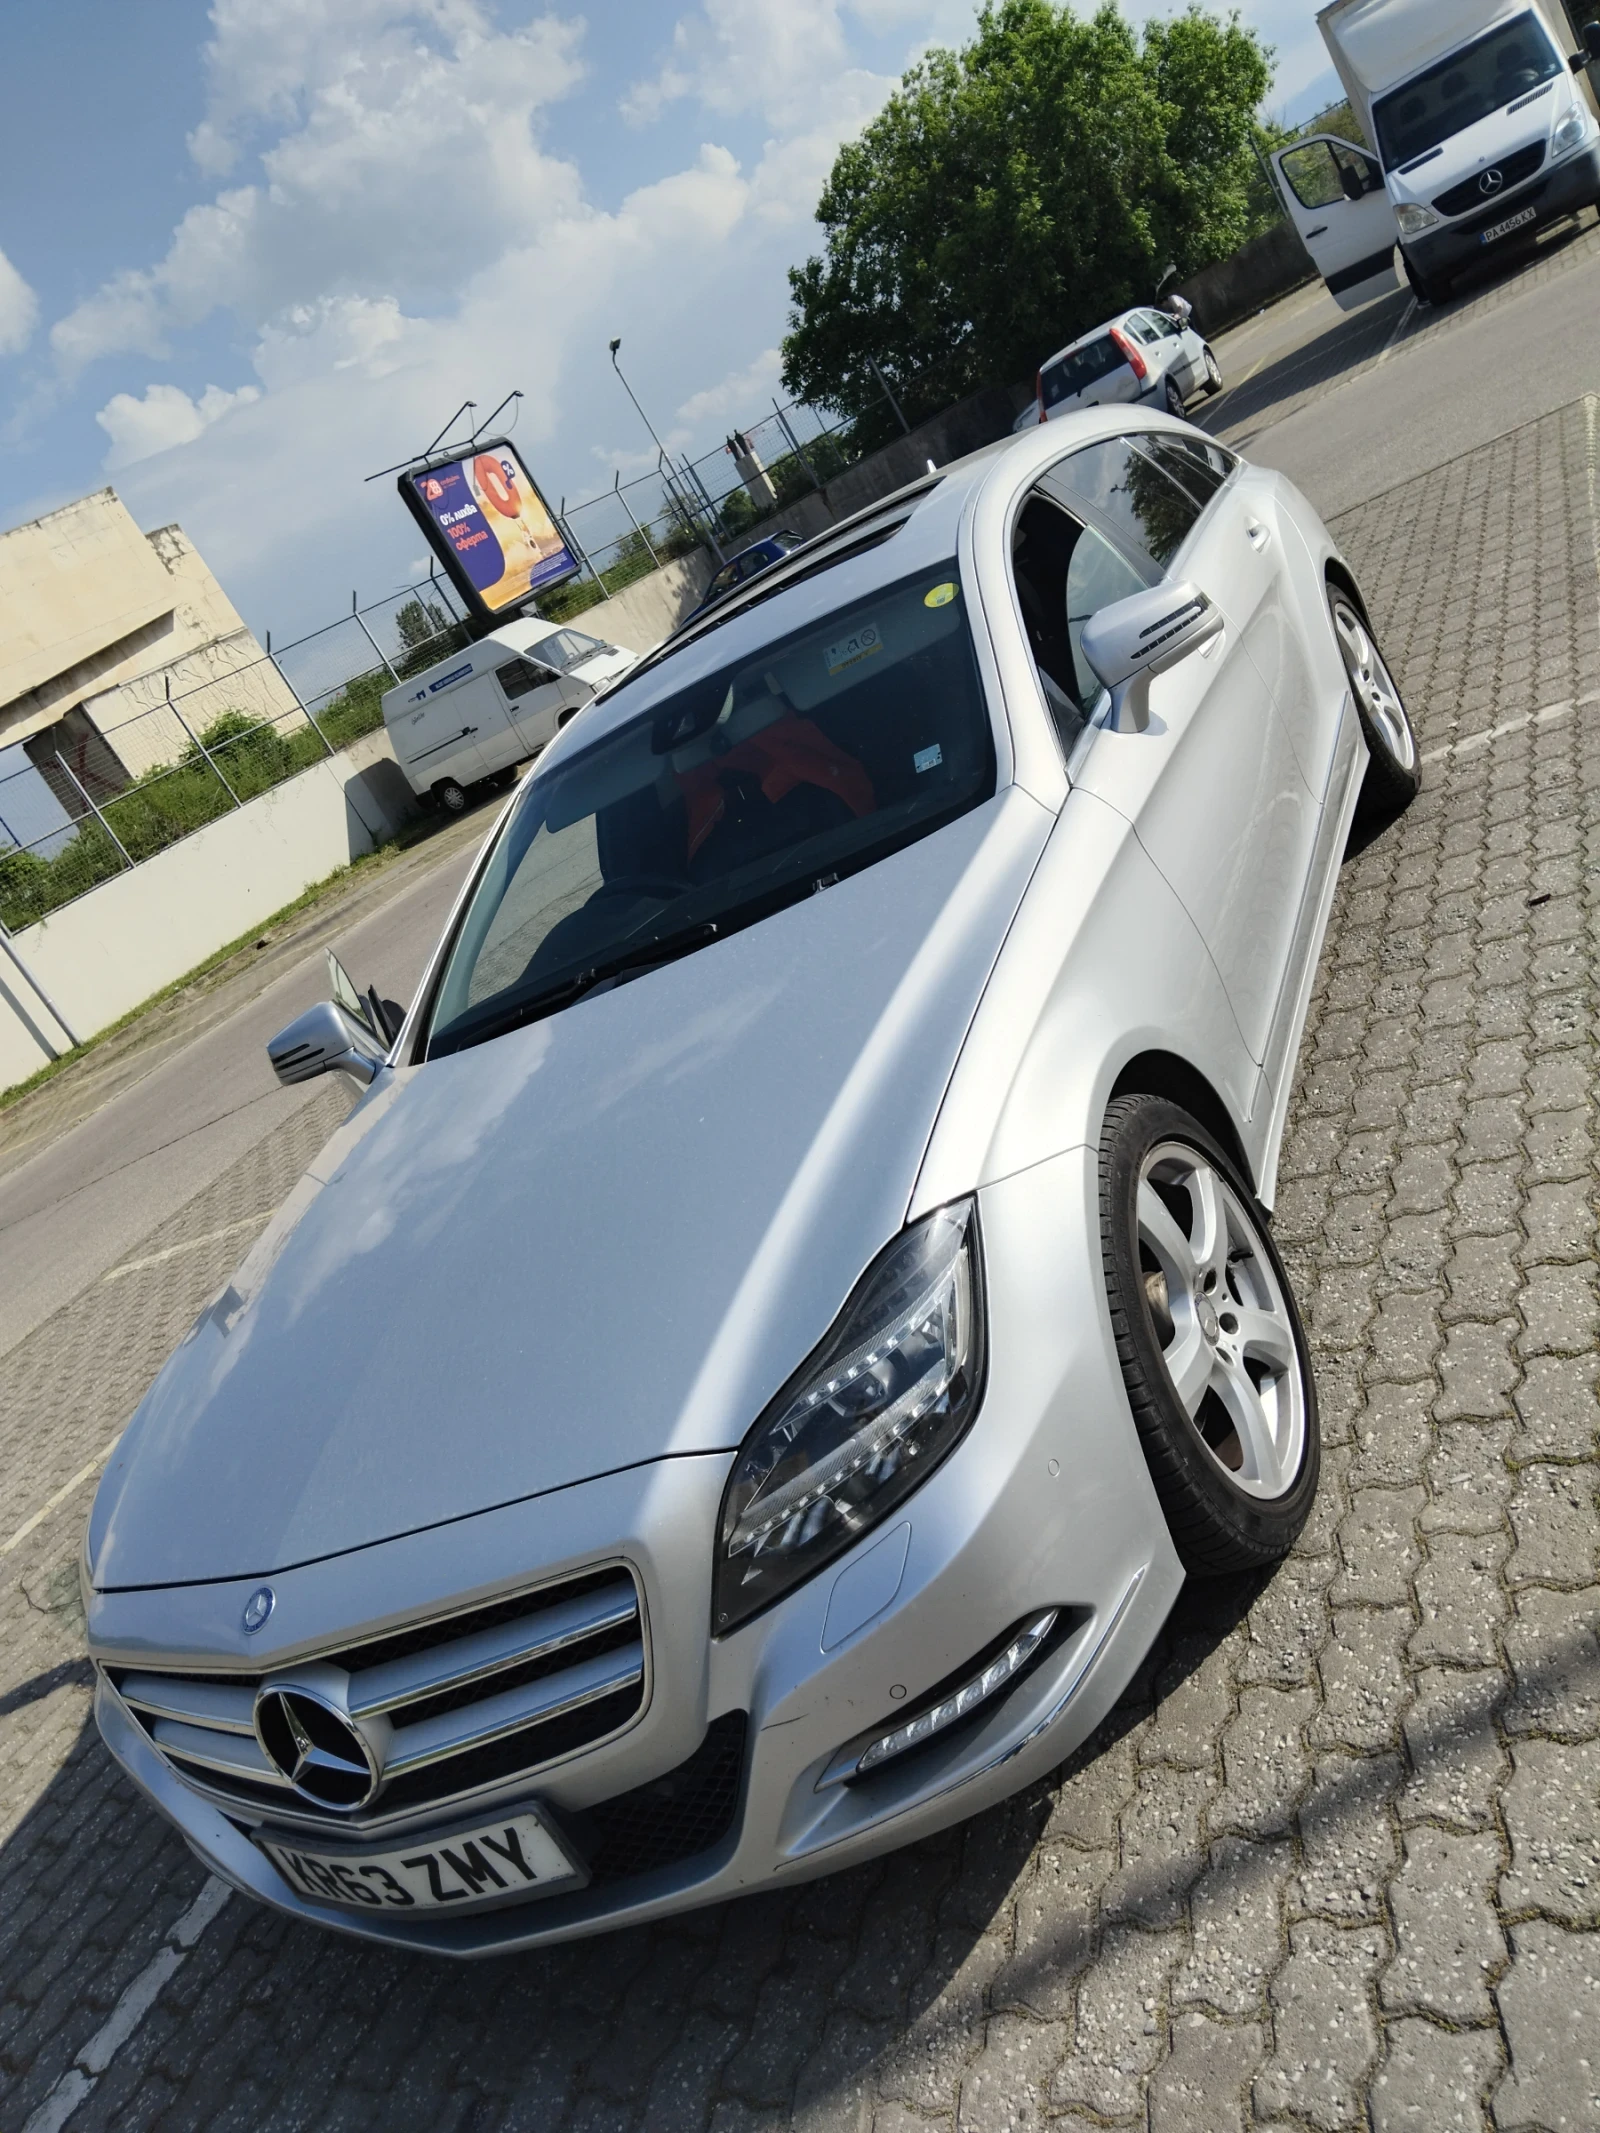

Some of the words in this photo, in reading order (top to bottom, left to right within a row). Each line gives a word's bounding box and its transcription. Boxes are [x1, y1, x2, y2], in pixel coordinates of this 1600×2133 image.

[1485, 228, 1499, 240] PA
[1500, 217, 1521, 233] 4456
[1520, 209, 1535, 222] KX
[440, 512, 455, 526] 0%
[454, 504, 478, 520] лихва
[447, 522, 471, 539] 100%
[456, 532, 488, 551] оферта
[278, 1848, 415, 1905] KR63
[400, 1827, 537, 1902] ZMY
